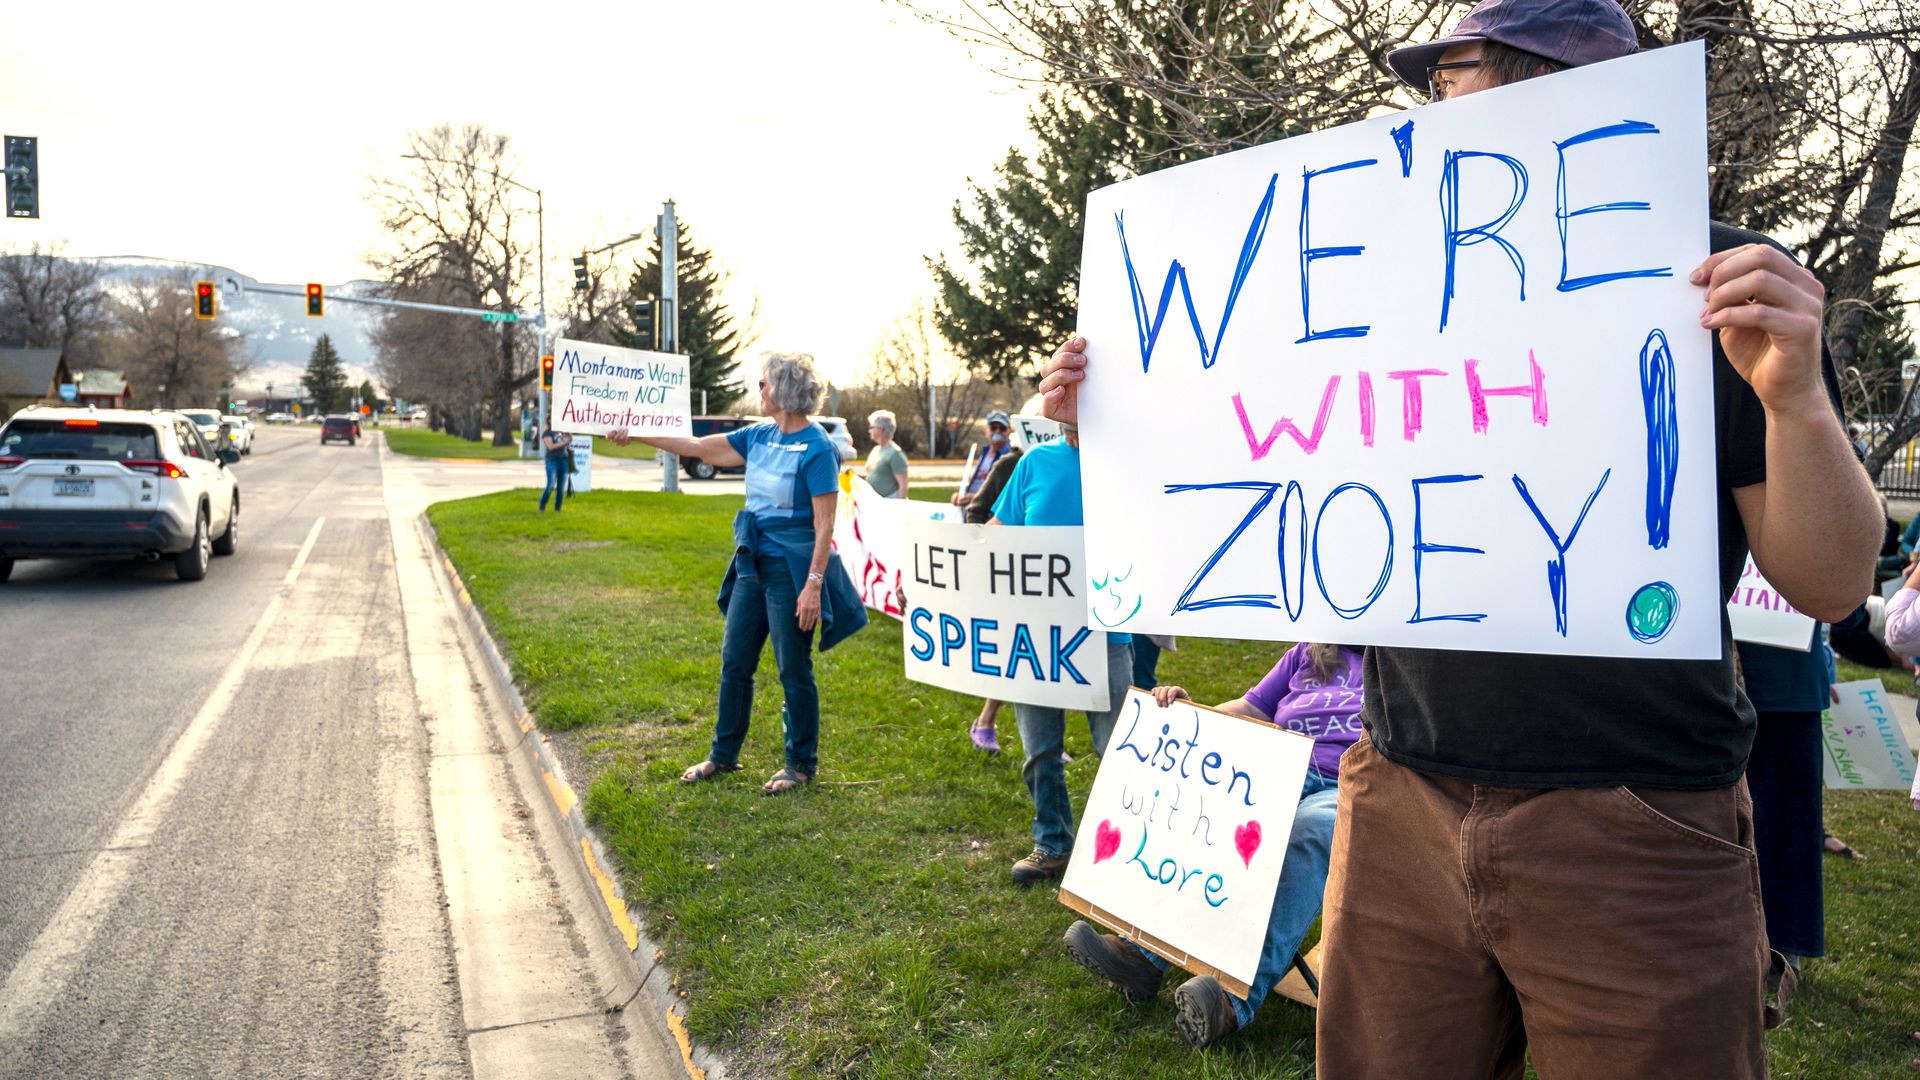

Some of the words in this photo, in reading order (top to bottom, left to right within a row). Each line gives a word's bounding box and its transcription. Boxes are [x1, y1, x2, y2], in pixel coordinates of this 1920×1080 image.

[1114, 119, 1674, 374] WE'RE
[559, 349, 645, 381] Montanans
[648, 361, 688, 386] Want
[570, 375, 629, 402] Freedom
[634, 385, 676, 405] NOT
[561, 398, 684, 428] Authoritarians
[1231, 347, 1549, 461] WITH
[914, 542, 967, 592] LET
[989, 551, 1076, 598] HER
[910, 606, 1092, 686] SPEAK
[1116, 697, 1257, 807] Listen
[1288, 713, 1363, 737] PEAC
[1122, 783, 1213, 847] with
